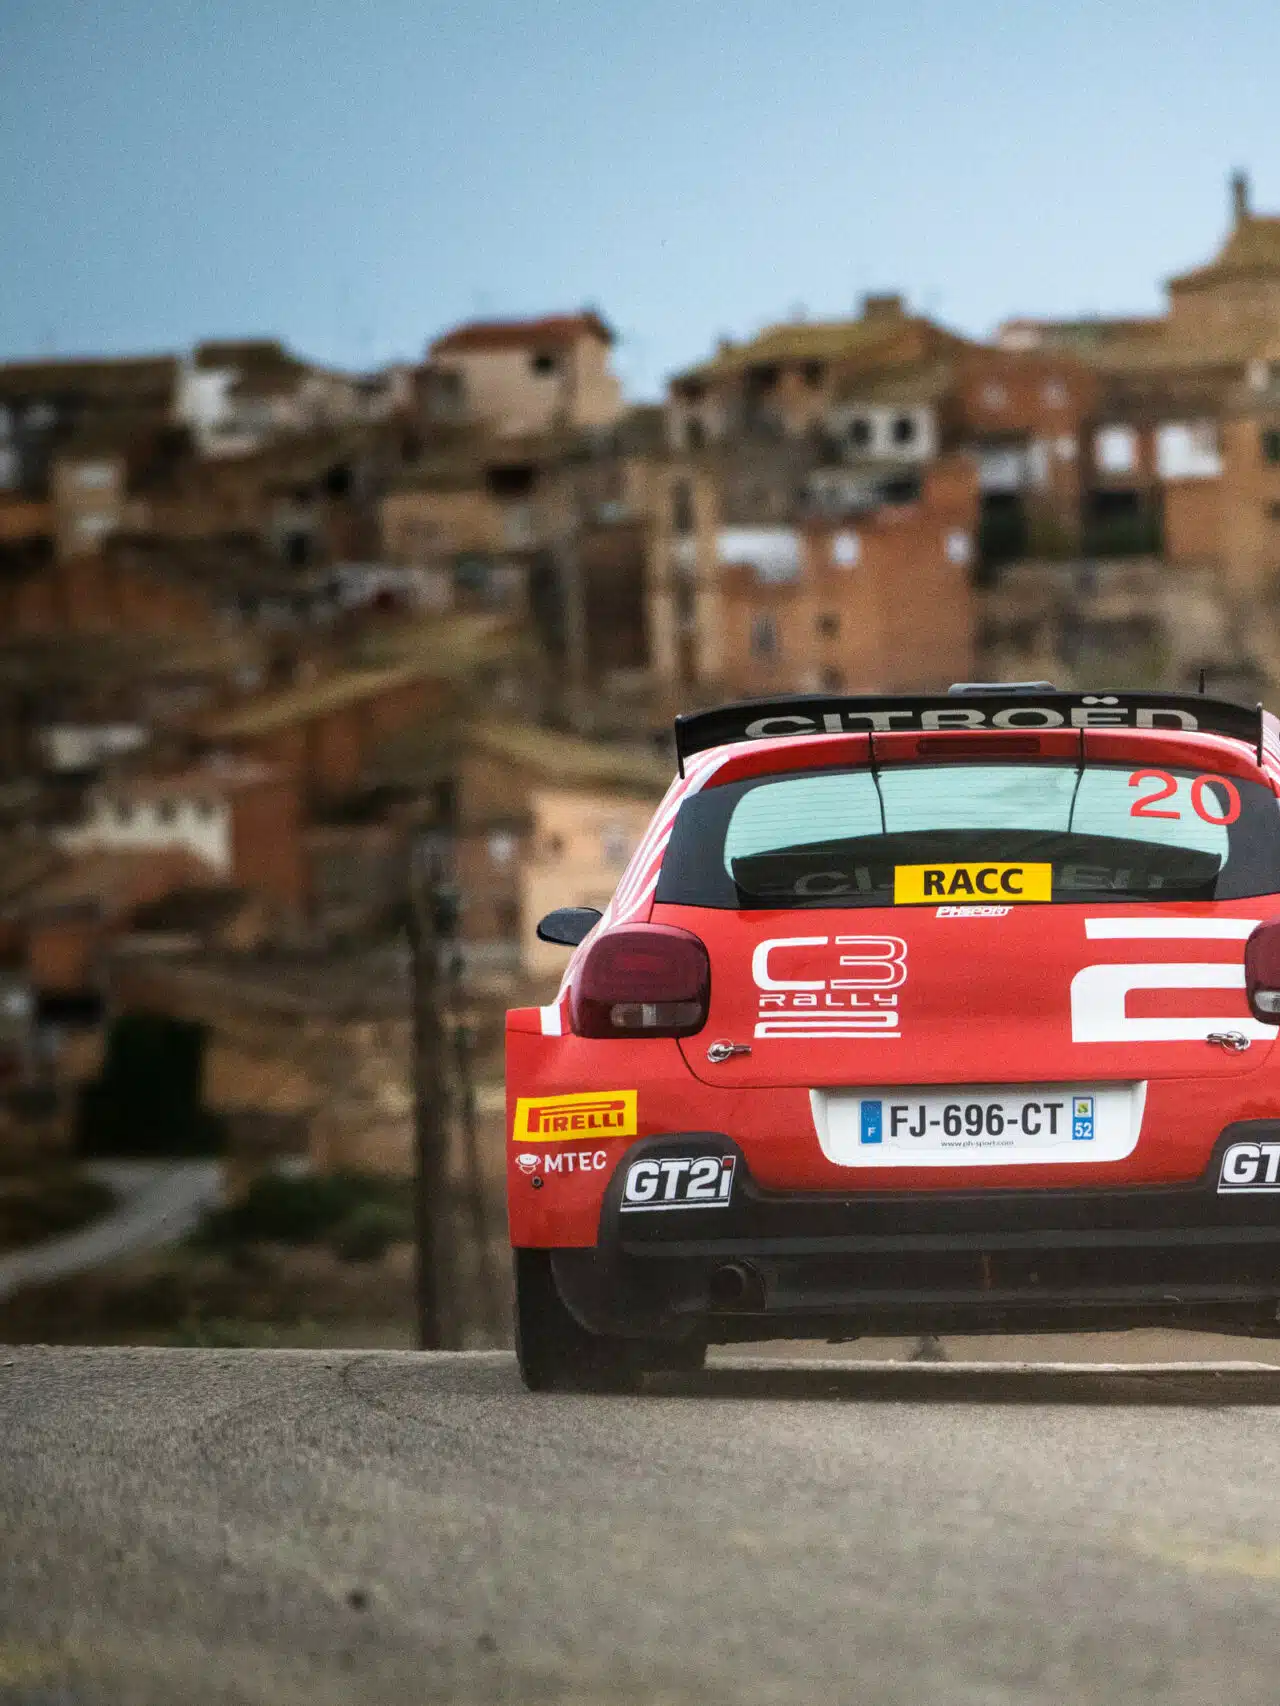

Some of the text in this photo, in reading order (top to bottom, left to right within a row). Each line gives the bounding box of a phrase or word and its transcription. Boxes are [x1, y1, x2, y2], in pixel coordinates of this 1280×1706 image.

[1127, 769, 1242, 825] 20
[923, 868, 1023, 896] RACC
[752, 935, 908, 991] C3
[526, 1100, 626, 1133] PIRELLI
[867, 1102, 1093, 1138] F FJ-696-CT 52
[543, 1150, 608, 1174] MTEC
